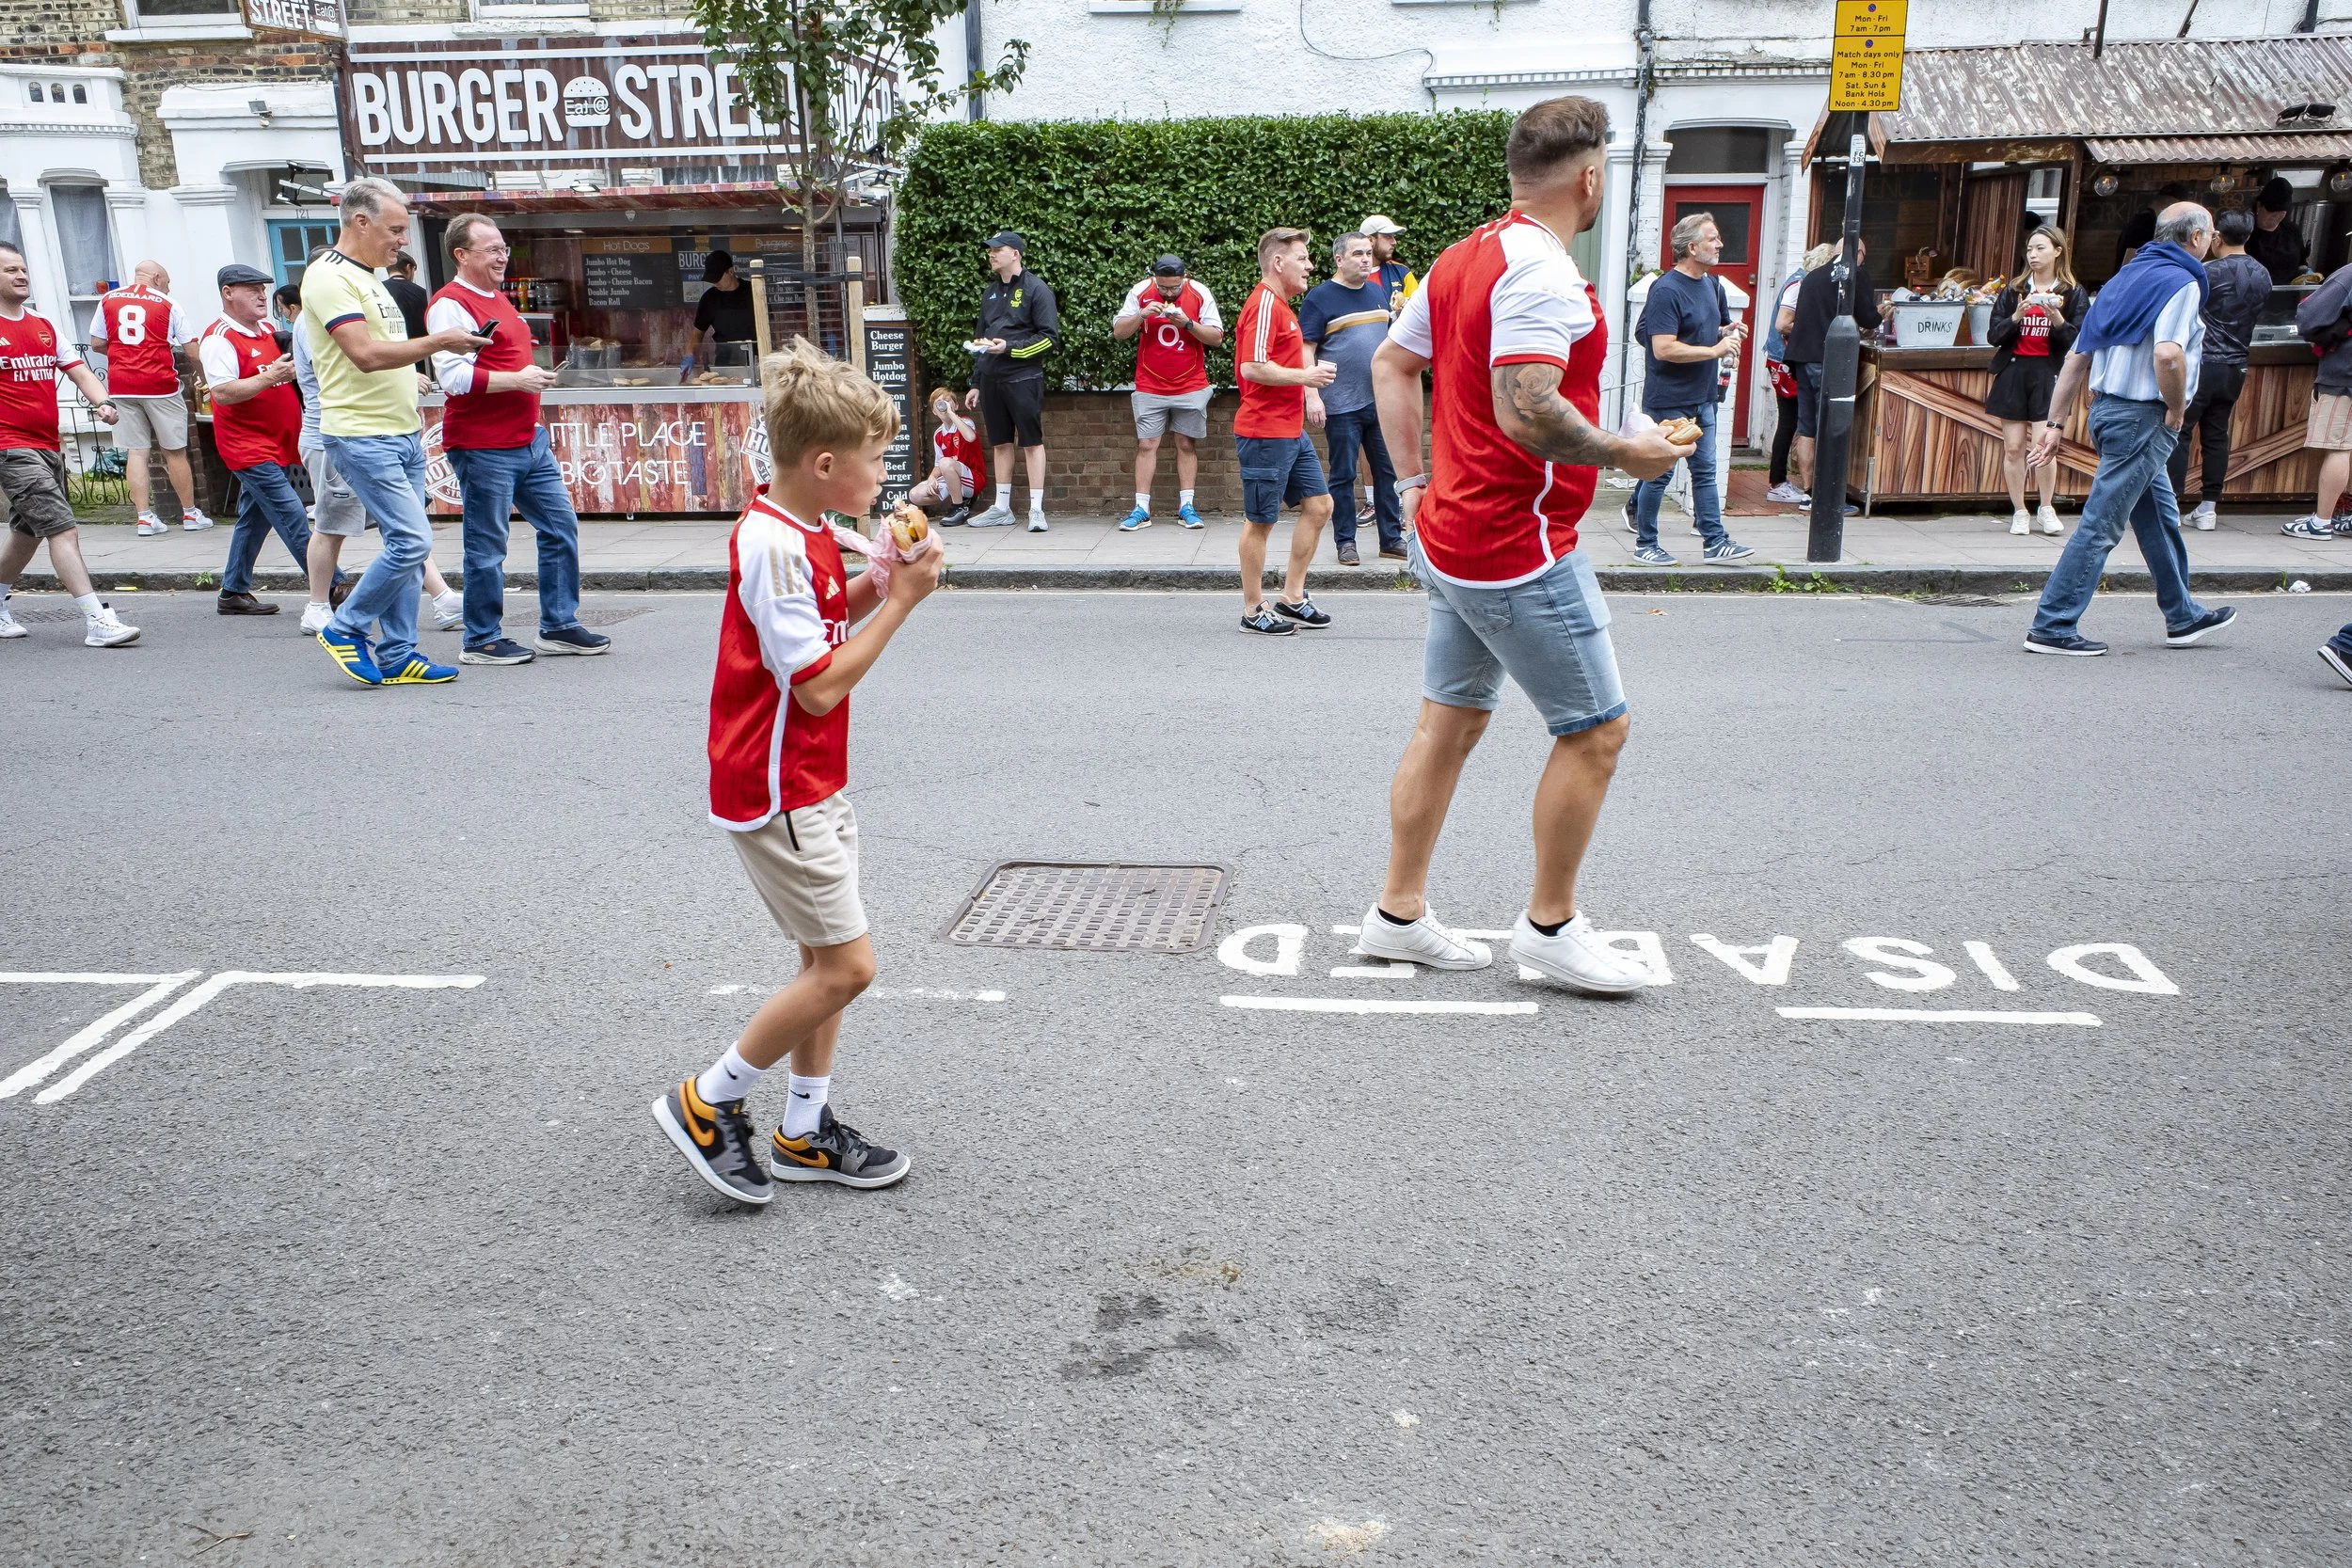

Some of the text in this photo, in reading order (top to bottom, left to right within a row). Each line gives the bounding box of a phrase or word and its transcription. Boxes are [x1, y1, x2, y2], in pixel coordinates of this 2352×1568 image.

[249, 0, 311, 30] STREET
[353, 68, 564, 146] BURGER
[1867, 177, 1912, 198] ENU
[295, 208, 310, 219] 121
[585, 257, 631, 266] Jumbo Hot Dog
[678, 252, 710, 268] BURG
[611, 267, 632, 276] Cheese
[587, 277, 607, 286] Jumbo
[612, 277, 632, 285] Cheese
[587, 287, 629, 295] Double Jumbo
[588, 297, 621, 306] Bacon Roll
[119, 304, 146, 345] 8
[1917, 321, 1953, 334] DRINKS
[870, 331, 904, 340] Cheese
[871, 341, 904, 352] Burger
[873, 361, 905, 371] Jumbo
[14, 369, 28, 382] FLY
[872, 372, 907, 382] Hotdog
[549, 422, 613, 447] ITTLE
[884, 461, 907, 470] Beef
[560, 460, 691, 485] BIG TASTE
[887, 473, 913, 482] urger
[886, 490, 908, 500] Cold
